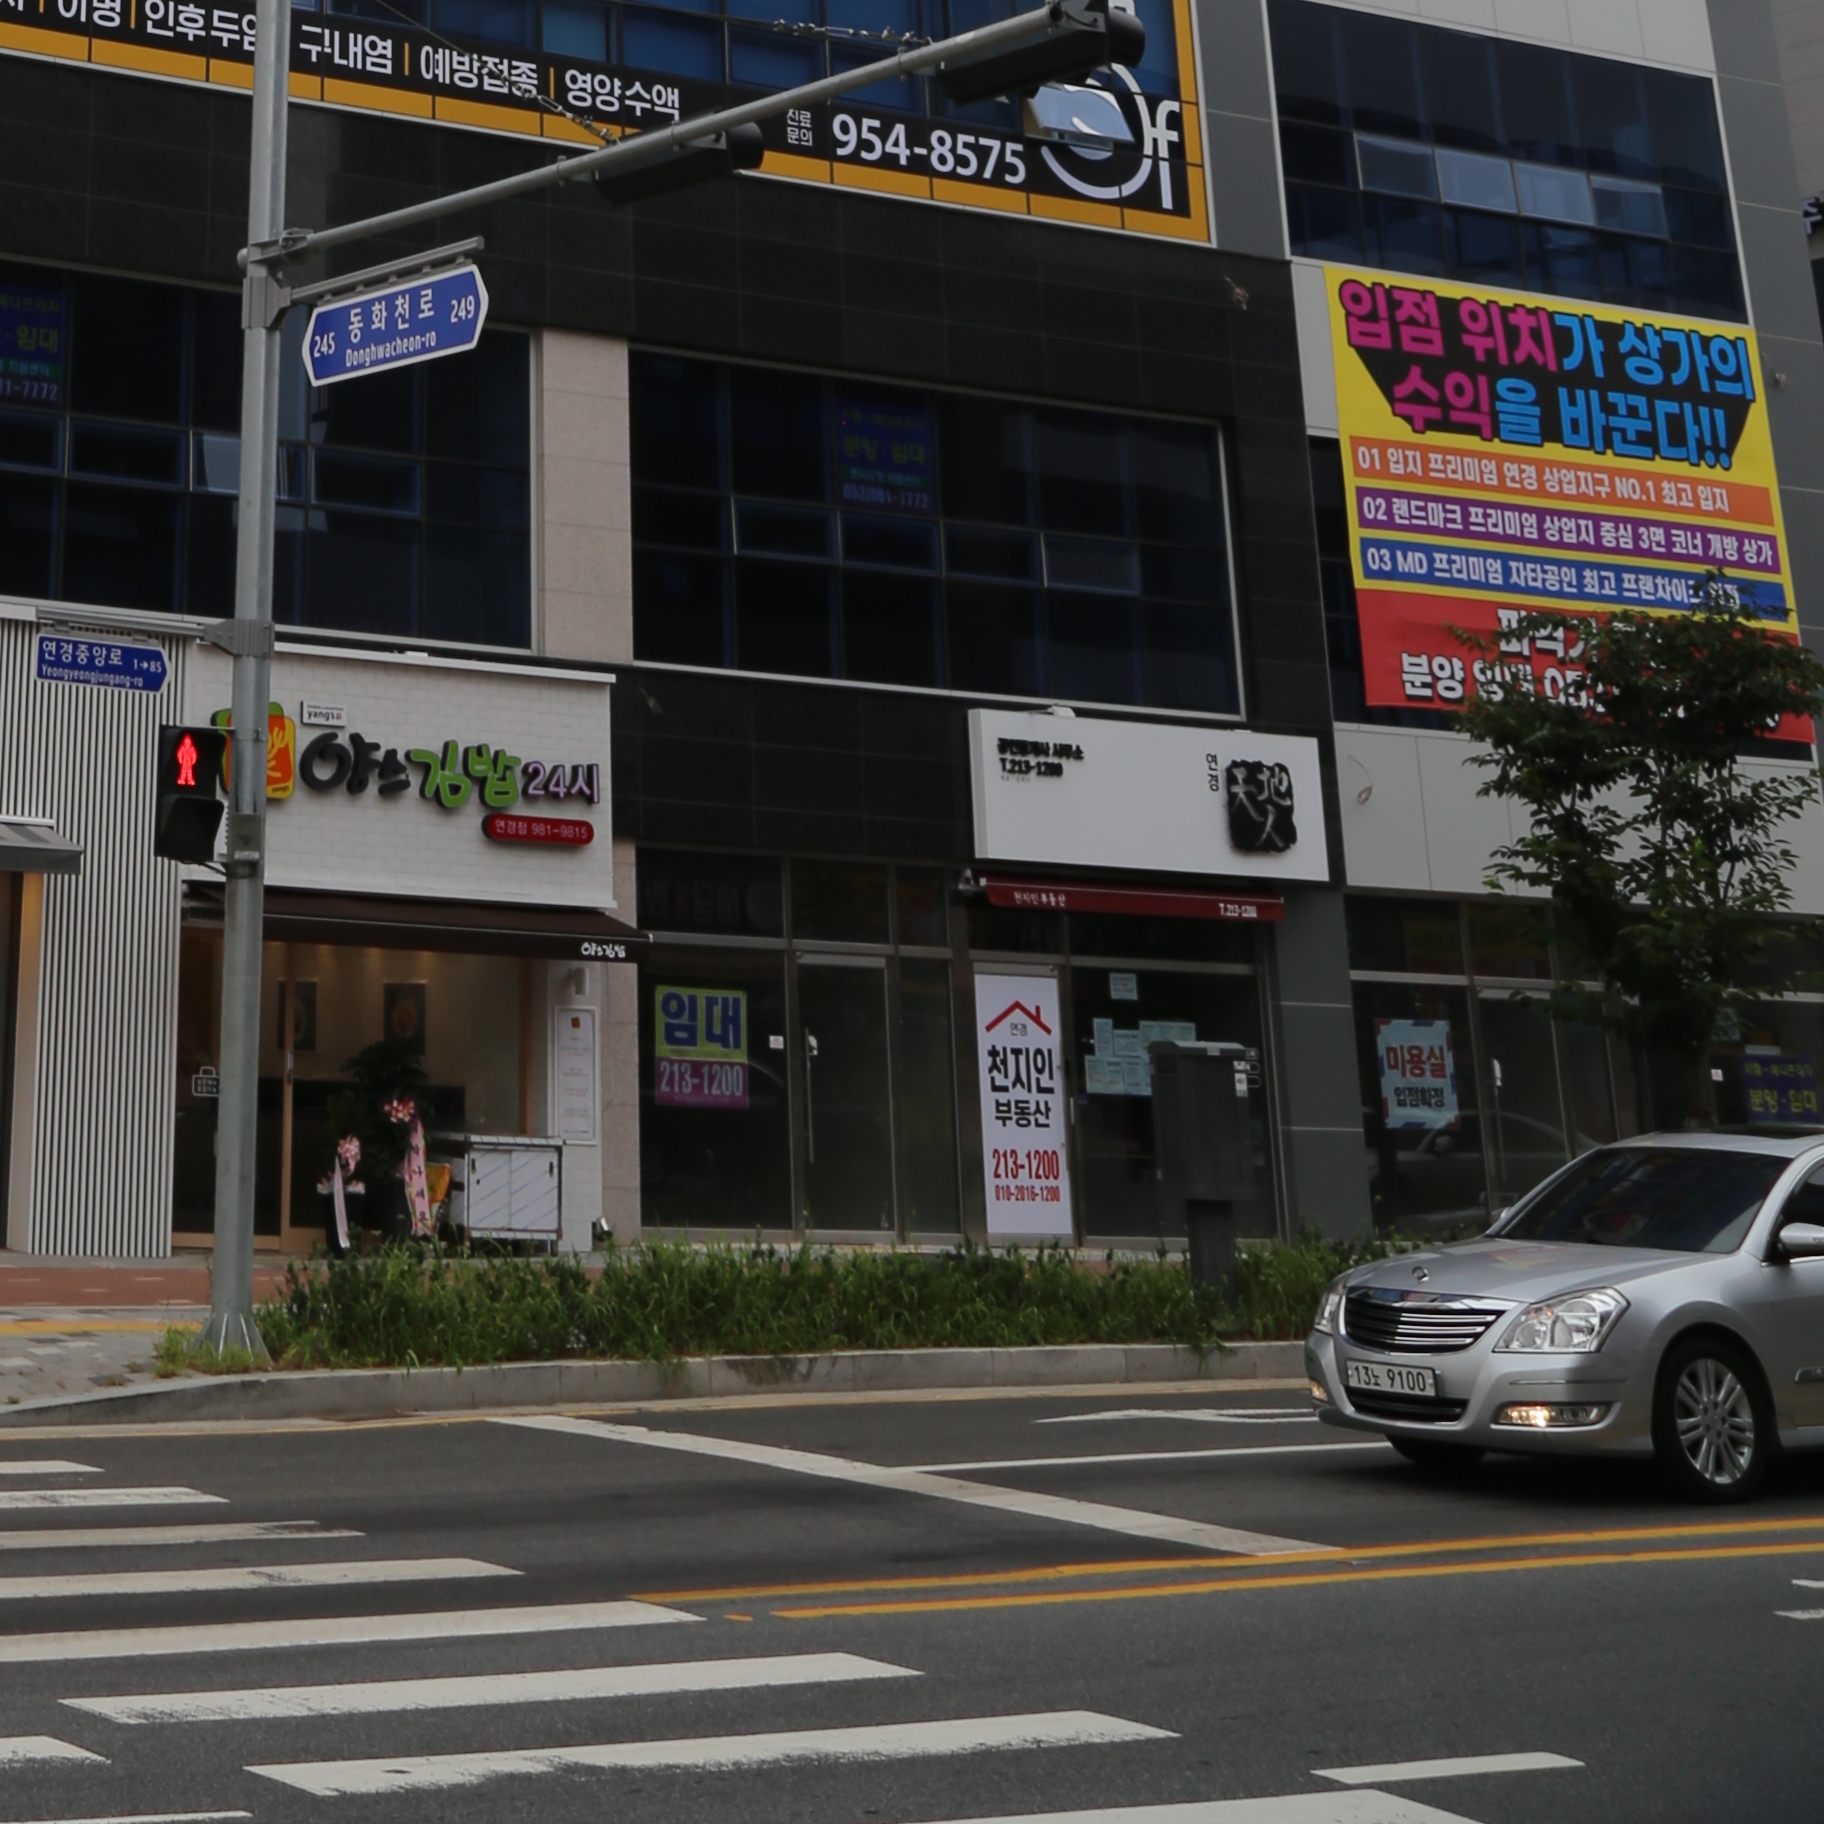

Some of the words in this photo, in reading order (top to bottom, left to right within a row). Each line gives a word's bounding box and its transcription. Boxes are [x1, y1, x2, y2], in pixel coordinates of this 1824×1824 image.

[299, 24, 393, 75] 구내염
[419, 43, 539, 96] 예방접종
[563, 70, 681, 121] 영양수액
[786, 127, 814, 147] 문의
[831, 112, 1027, 184] 954-8575
[17, 324, 58, 353] 임대
[313, 332, 335, 358] 245
[348, 288, 435, 344] 동화천로
[450, 295, 475, 323] 249
[346, 331, 437, 367] Donghwacheon-ro
[1339, 278, 1445, 358] 입점
[1458, 297, 1606, 379] 위치가
[1618, 319, 1756, 404] 상가의
[1392, 364, 1544, 448] 수익을
[1557, 384, 1732, 470] 바꾼다!!
[1358, 450, 1380, 471] 01
[1387, 448, 1423, 476] 입지
[1429, 454, 1499, 487] 프리미엄
[1503, 463, 1539, 491] 연경
[1543, 468, 1611, 500] 상업지구
[1614, 480, 1657, 503] NO.1
[1661, 482, 1694, 508] 최고
[1698, 488, 1730, 514] 입지
[1362, 495, 1387, 521] 02
[1392, 496, 1463, 530] 랜드마크
[1468, 506, 1539, 539] 프리미엄
[1543, 515, 1595, 546] 상업지
[1600, 521, 1634, 550] 중심
[1638, 527, 1667, 553] 3면
[1670, 529, 1703, 557] 코너
[1708, 533, 1738, 562] 개방
[1742, 538, 1773, 566] 상가
[1367, 547, 1392, 571] 03
[1396, 549, 1427, 575] MD
[1433, 553, 1502, 586] 프리미엄
[1509, 560, 1577, 594] 자타공인
[1582, 568, 1616, 597] 최고
[42, 640, 123, 667] 연경중앙로
[41, 663, 144, 688] Yeongyeongjungang-ro
[1401, 652, 1465, 701] 분양
[525, 760, 601, 805] 24시
[1205, 752, 1220, 792] 연경
[495, 819, 528, 836] 연경점
[531, 822, 588, 840] 981-9815
[1014, 890, 1039, 905] 천지인
[1040, 892, 1066, 907] 부동산
[1218, 902, 1257, 918] T.213-1200
[660, 991, 742, 1050] 임대
[1008, 1021, 1028, 1038] 연경
[660, 1061, 744, 1096] 213-1200
[986, 1043, 1057, 1098] 천지인
[1385, 1044, 1447, 1079] 미용실
[993, 1098, 1052, 1131] 부동산
[1749, 1089, 1778, 1113] 분양
[992, 1148, 1061, 1183] 213-1200
[994, 1183, 1061, 1204] 010-2016-1200
[1352, 1361, 1382, 1387] 13노
[1387, 1365, 1430, 1393] 9100
